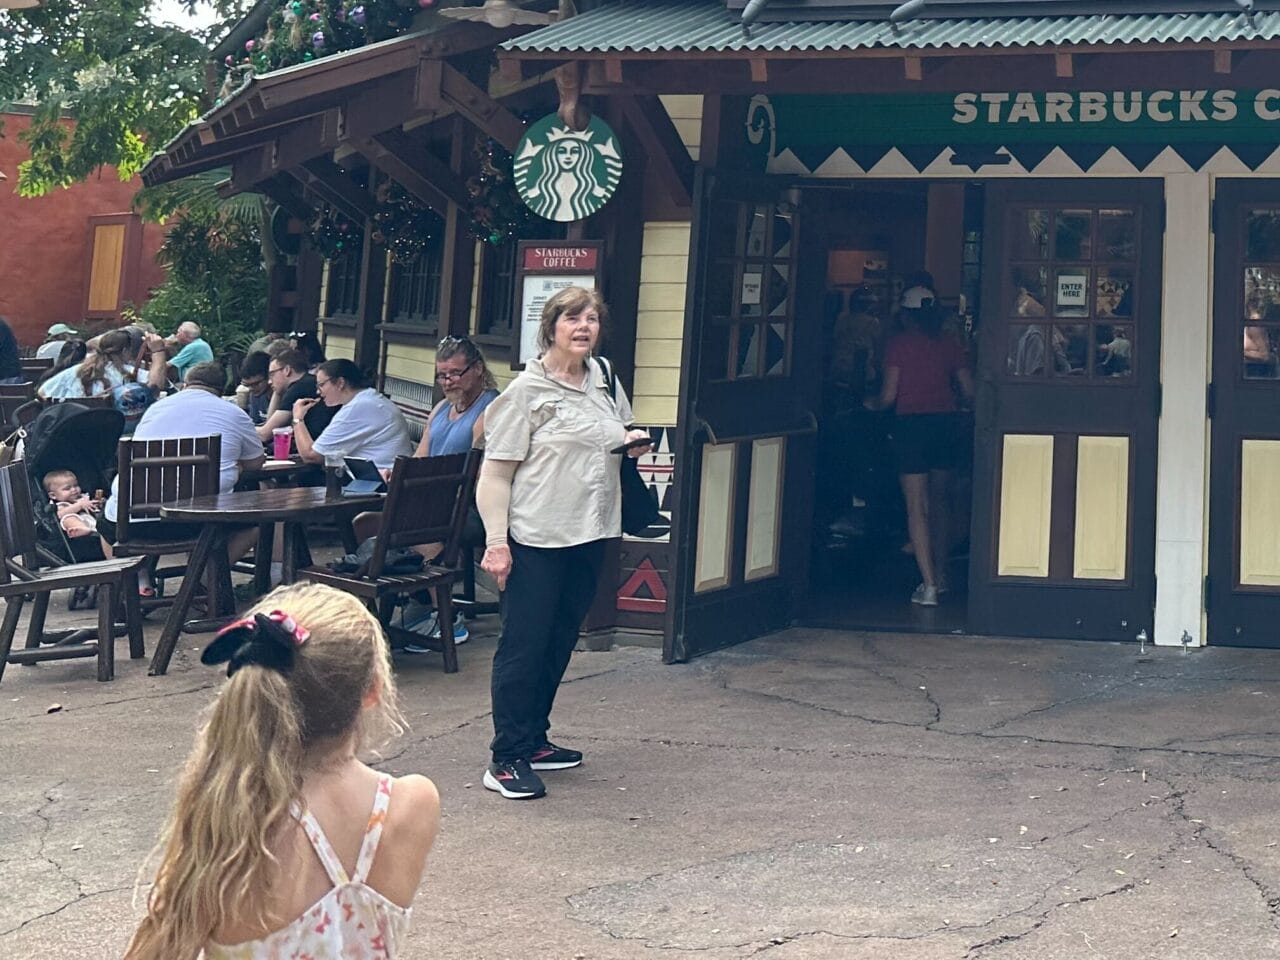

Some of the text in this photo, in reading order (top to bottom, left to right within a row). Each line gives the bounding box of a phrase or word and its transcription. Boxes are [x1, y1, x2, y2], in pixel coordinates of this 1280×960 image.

[951, 90, 1238, 124] STARBUCKS
[535, 248, 588, 258] STARBUCKS
[543, 257, 577, 268] COFFEE
